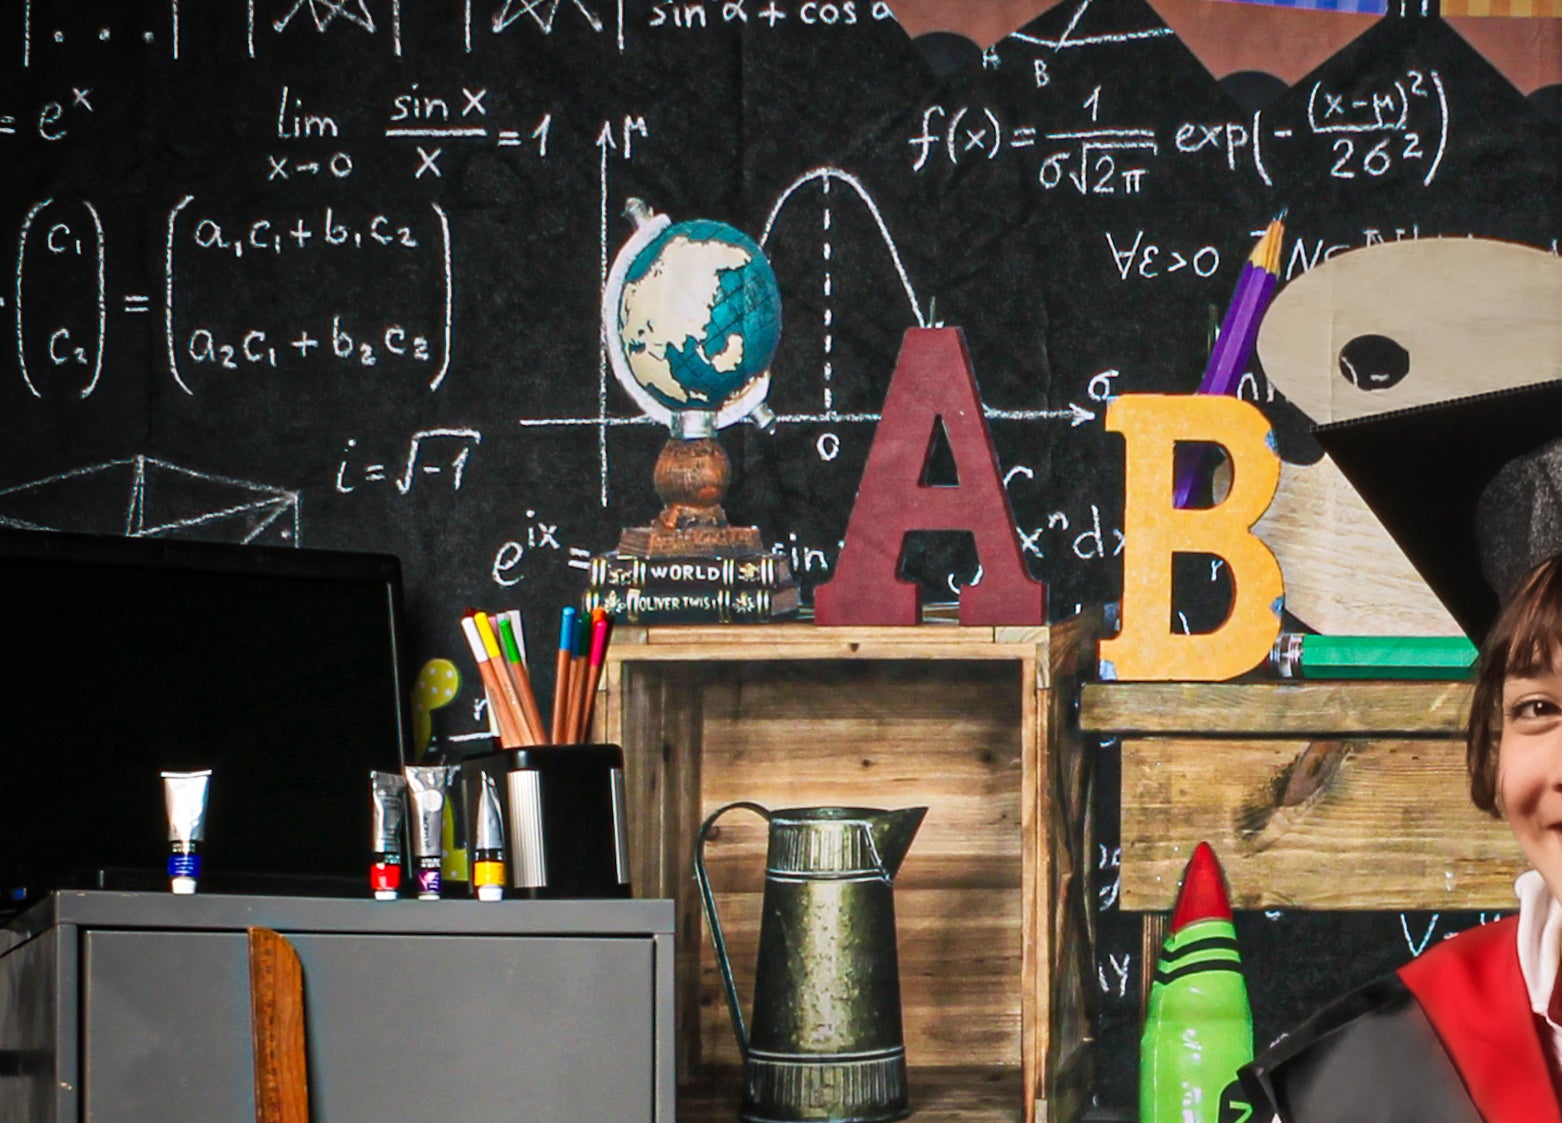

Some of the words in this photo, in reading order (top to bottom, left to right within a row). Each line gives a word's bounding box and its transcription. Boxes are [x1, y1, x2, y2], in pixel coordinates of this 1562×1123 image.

[276, 86, 339, 140] lim
[388, 84, 449, 122] sin
[814, 326, 1048, 626] A
[1100, 393, 1285, 682] B
[650, 563, 721, 582] WORLD
[638, 595, 680, 613] OLIVER
